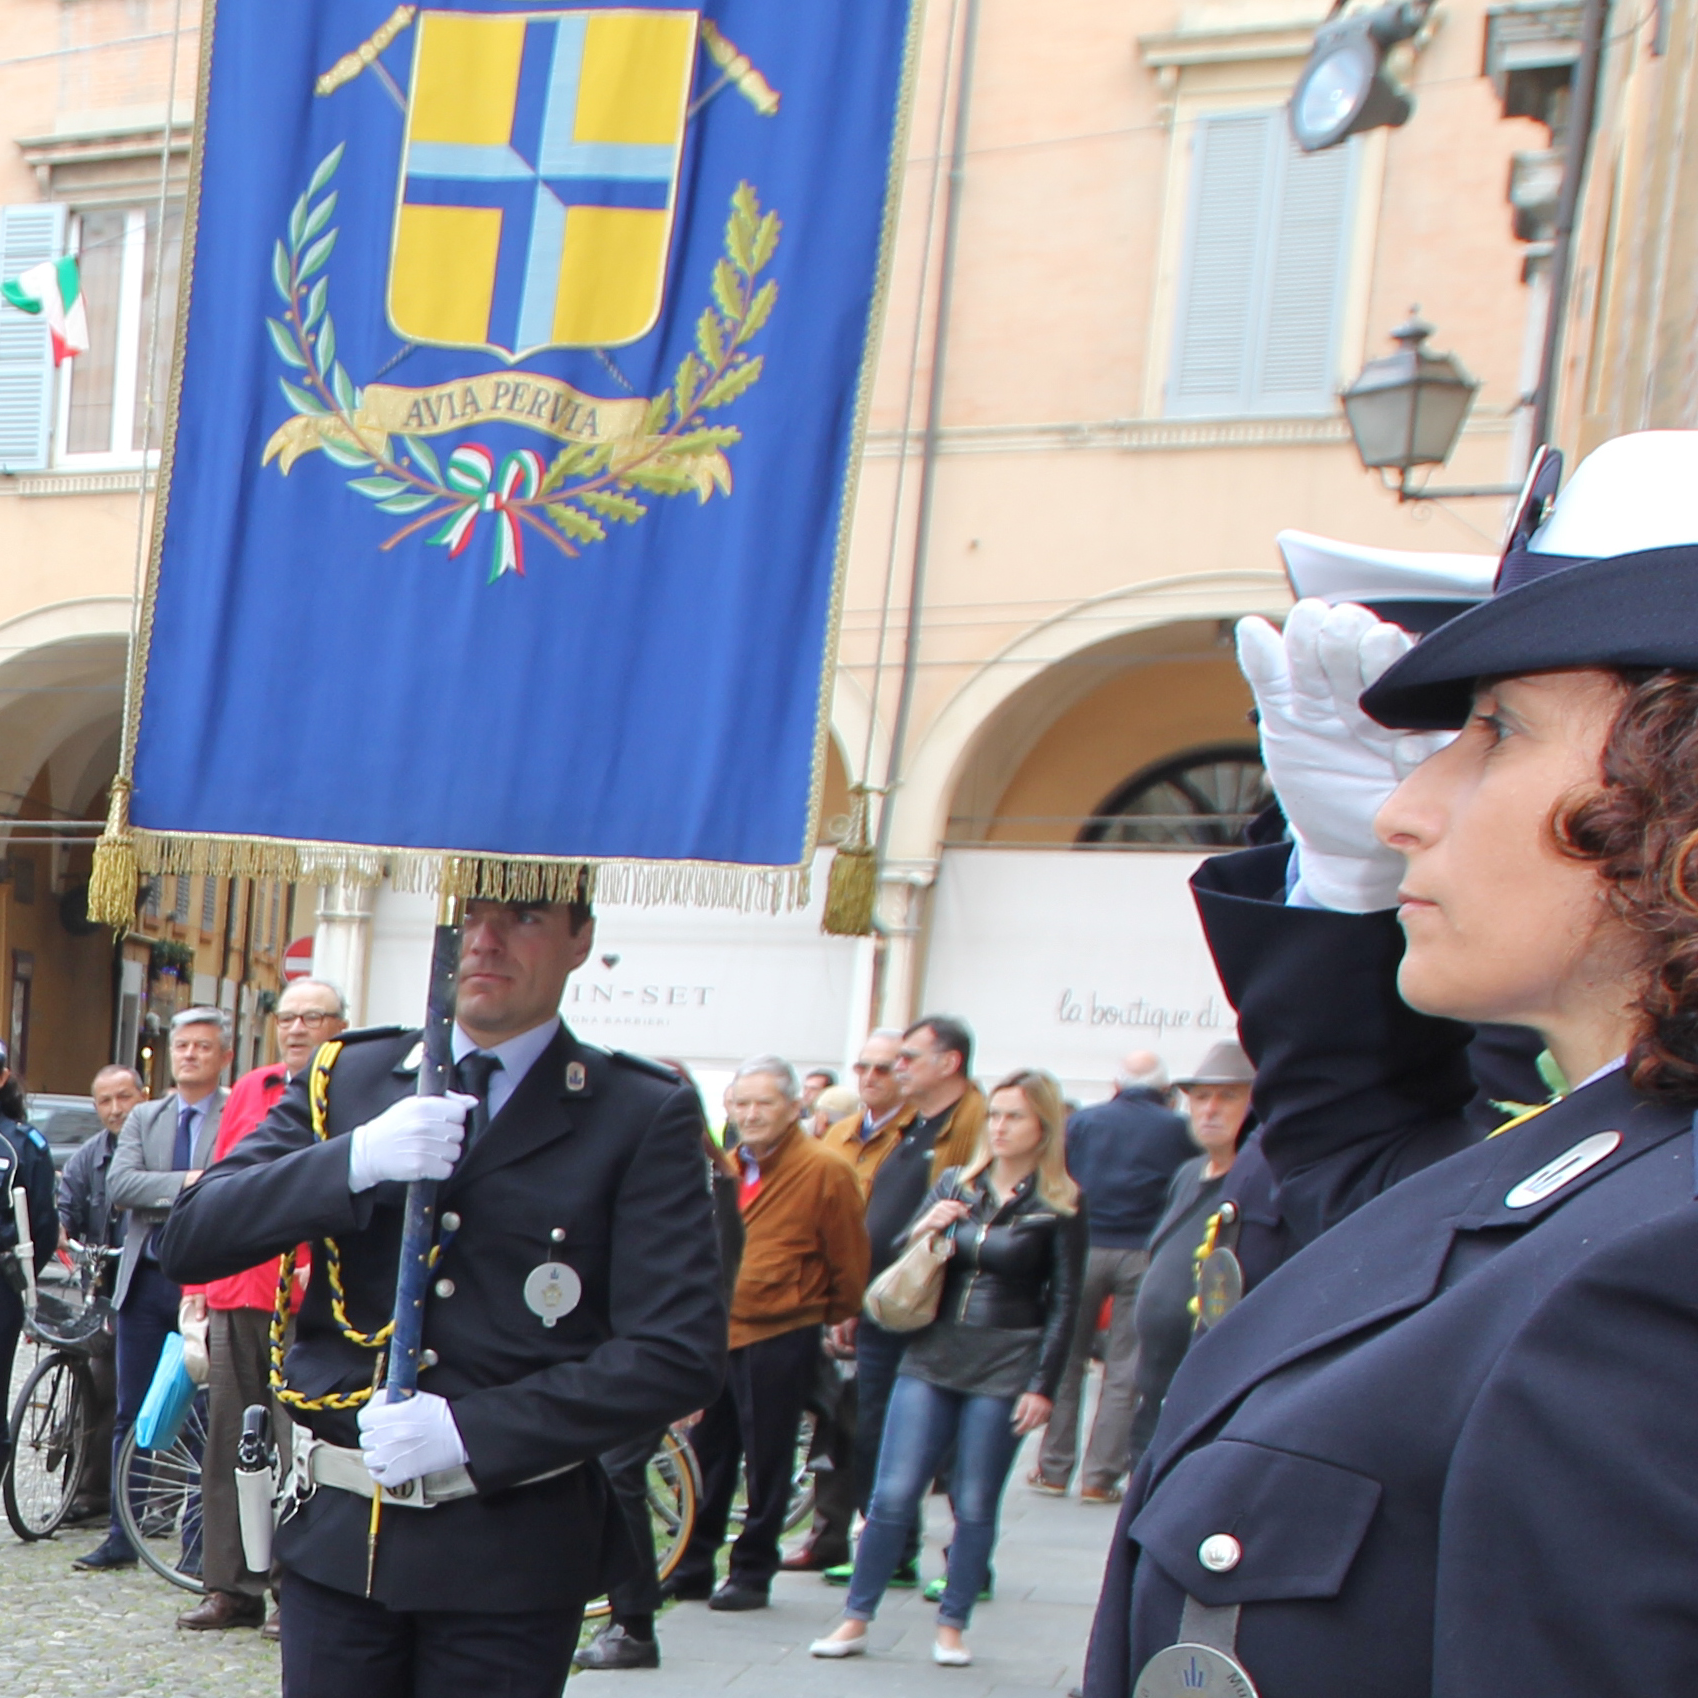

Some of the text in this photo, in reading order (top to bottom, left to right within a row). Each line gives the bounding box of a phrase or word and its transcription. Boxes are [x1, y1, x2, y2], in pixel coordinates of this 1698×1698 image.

[404, 380, 600, 437] AVIA PERVIA
[572, 983, 716, 1006] IN-SET
[1059, 987, 1221, 1038] la boutique di
